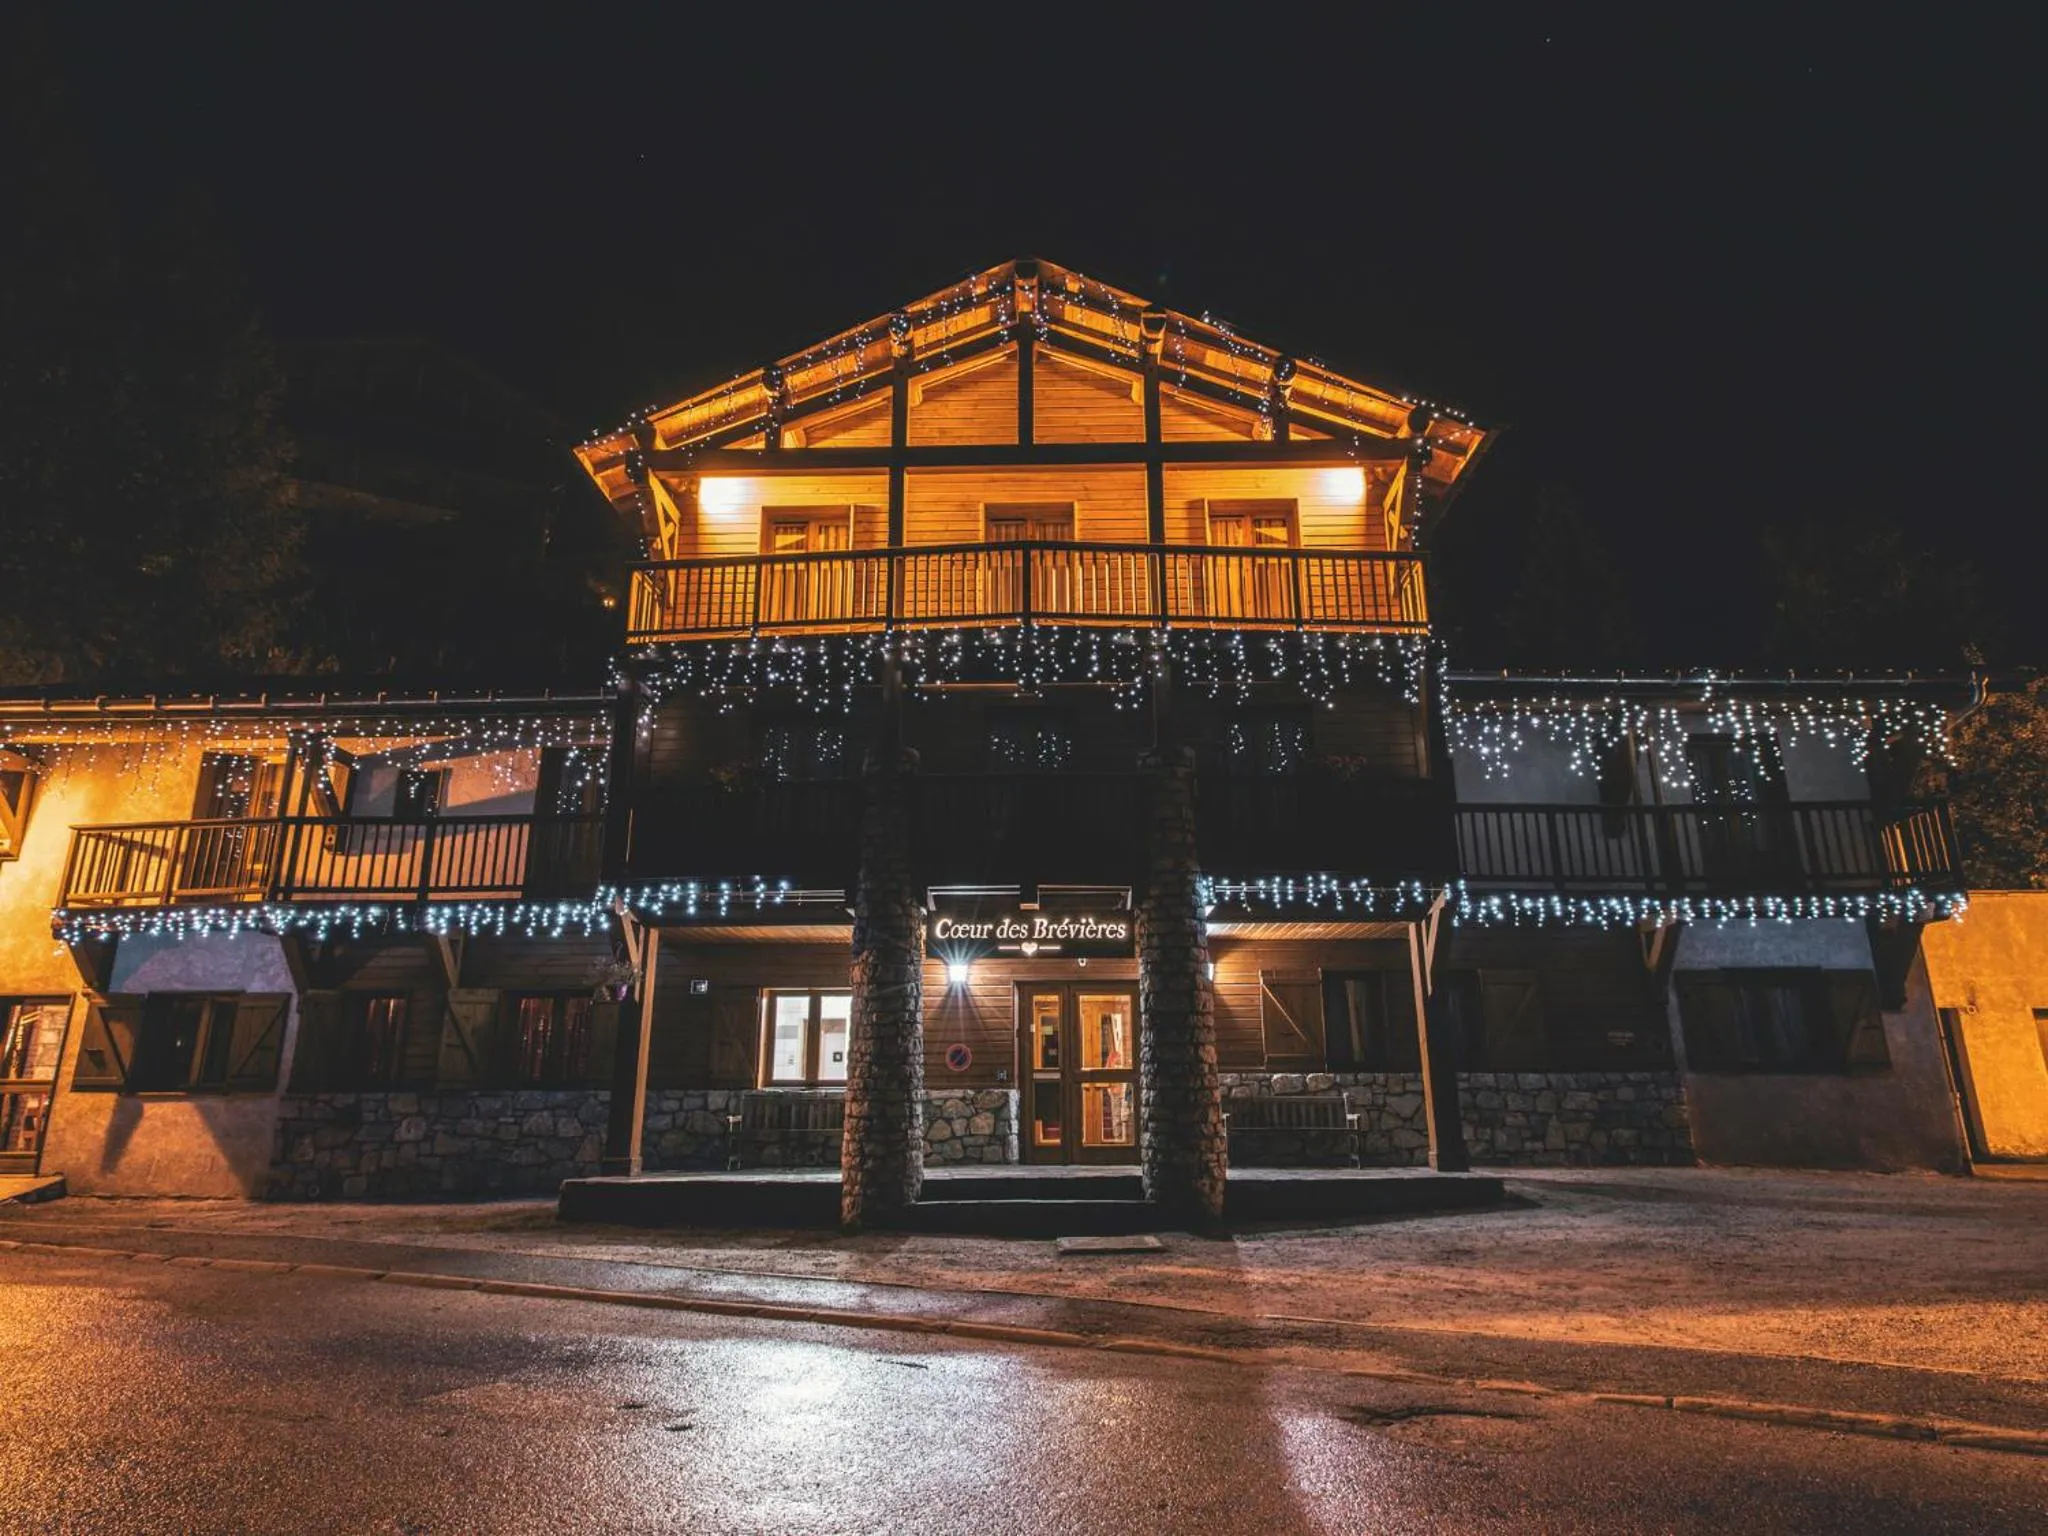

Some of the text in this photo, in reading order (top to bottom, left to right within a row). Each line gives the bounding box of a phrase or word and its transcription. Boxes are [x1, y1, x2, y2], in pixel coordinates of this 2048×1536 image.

[935, 917, 1126, 939] Cœur des Brévières
